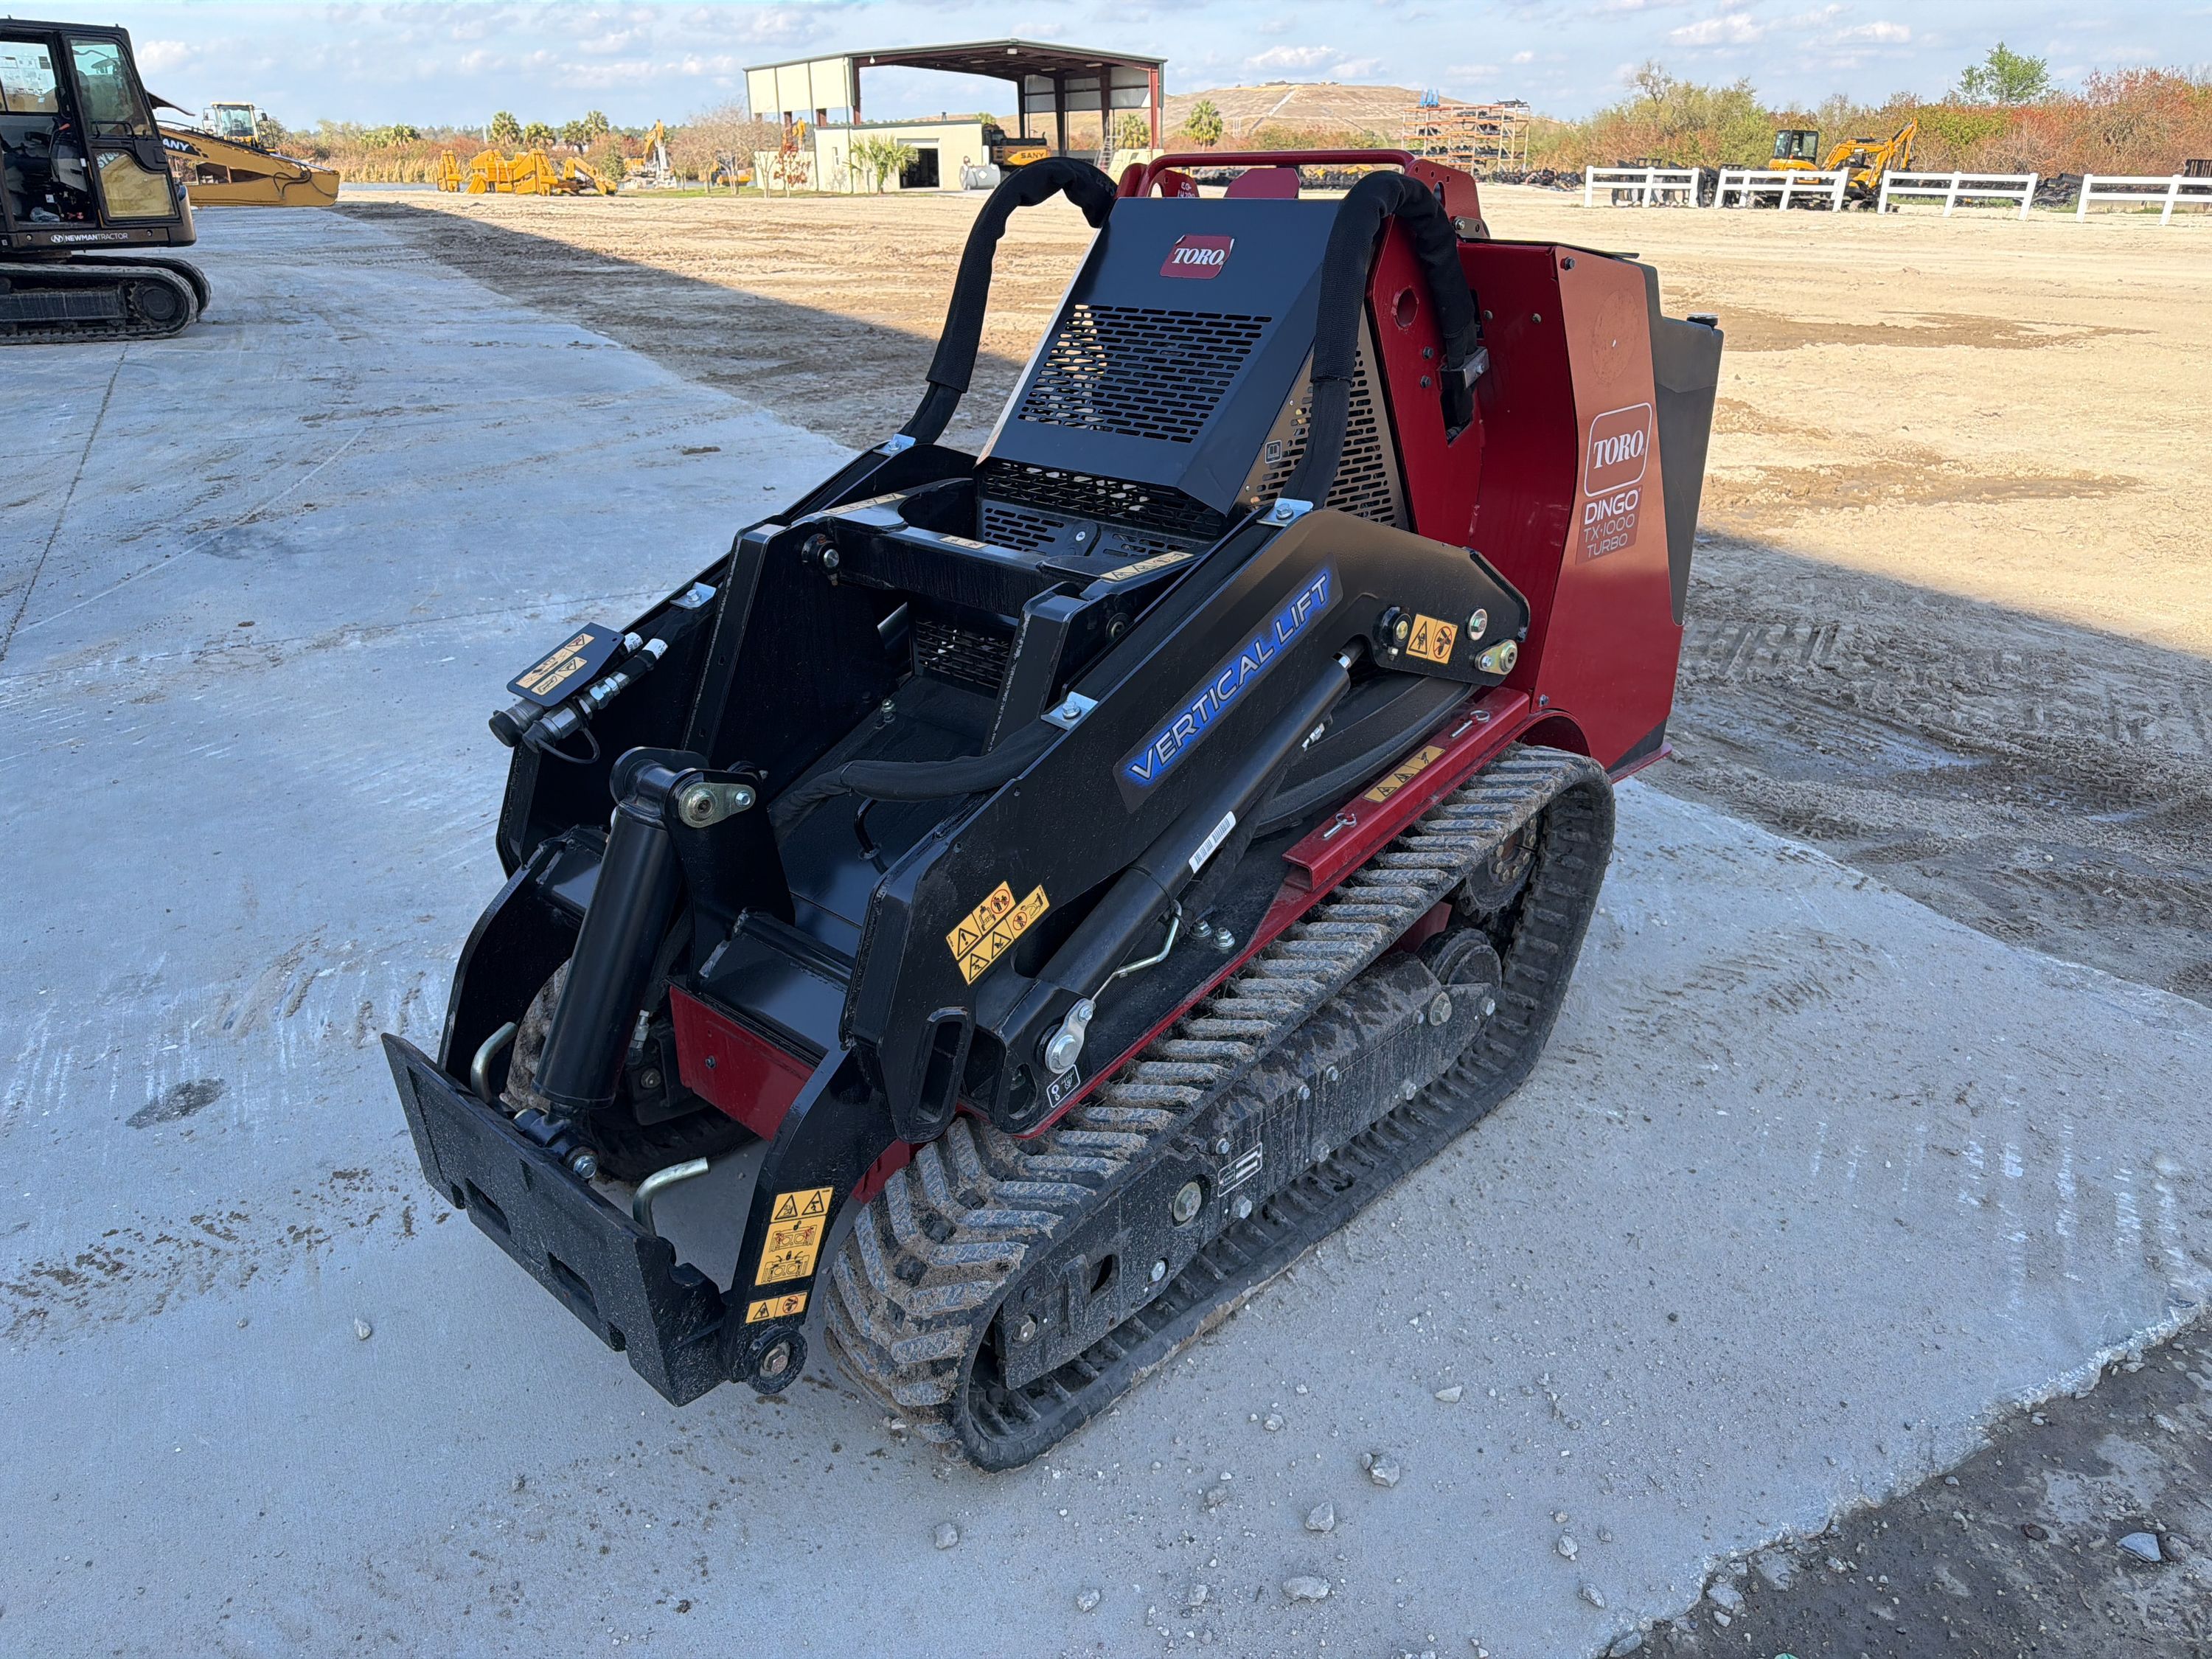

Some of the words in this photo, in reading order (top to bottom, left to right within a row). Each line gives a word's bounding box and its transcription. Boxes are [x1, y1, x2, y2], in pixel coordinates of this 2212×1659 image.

[162, 138, 189, 151] ANY
[1172, 248, 1225, 265] TORO
[1593, 429, 1644, 469] TORO
[1585, 489, 1639, 525] DINGO
[1587, 533, 1628, 558] TURBO
[1130, 639, 1275, 780] VERTICAL
[1274, 574, 1327, 645] LIFT
